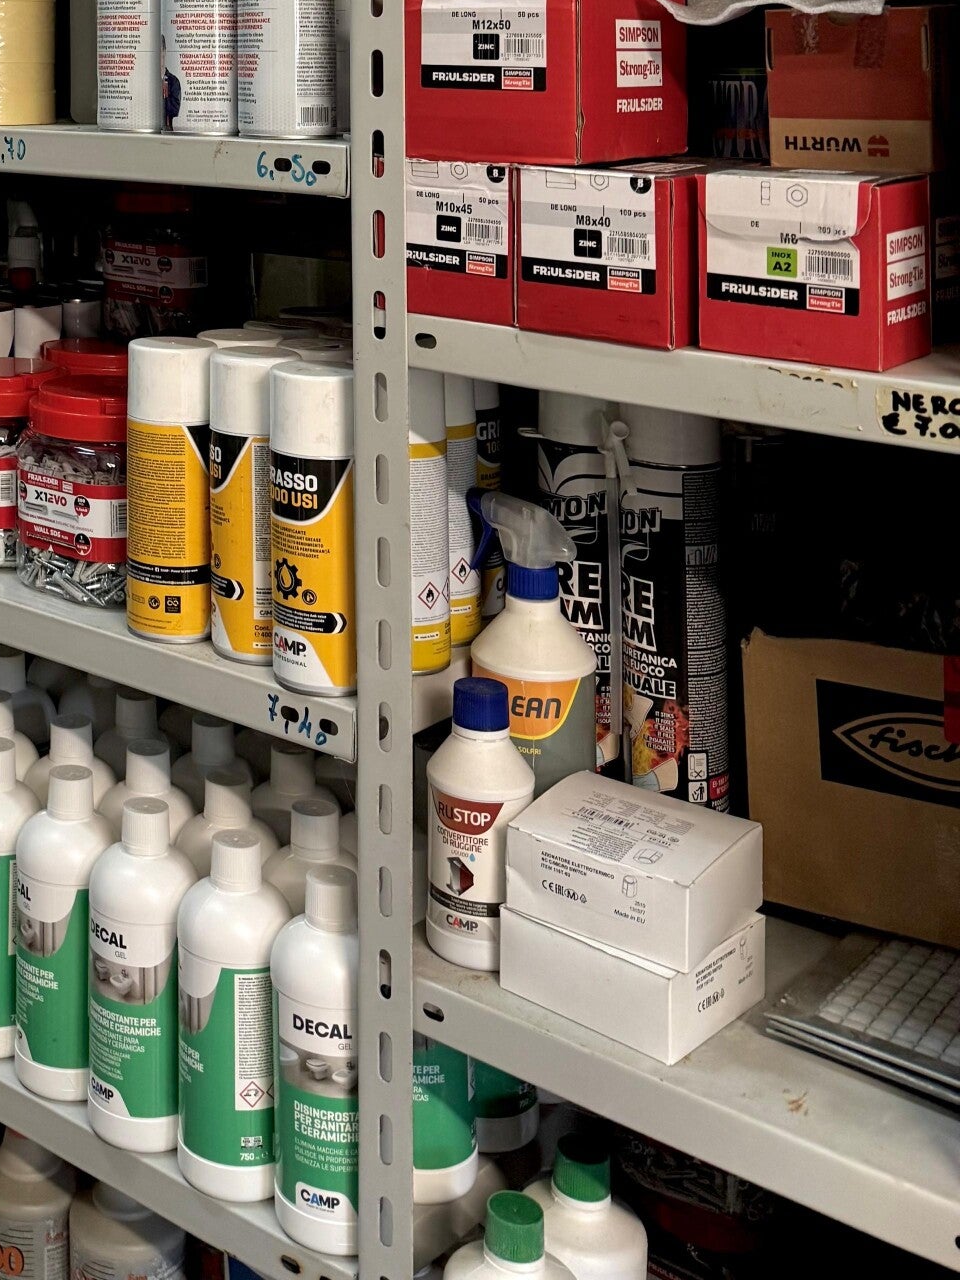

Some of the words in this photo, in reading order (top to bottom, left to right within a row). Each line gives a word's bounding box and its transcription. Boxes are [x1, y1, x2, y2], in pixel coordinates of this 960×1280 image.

[472, 19, 511, 31] M12x50
[619, 26, 659, 43] SIMPSON
[477, 43, 495, 51] ZINC
[435, 201, 473, 215] M10x45
[560, 204, 577, 212] LONG
[576, 214, 611, 228] M8x40
[578, 240, 597, 248] ZINC
[890, 234, 923, 255] SIMPSON
[771, 251, 792, 260] INOX
[610, 270, 638, 278] SIMPSON
[772, 262, 792, 273] A2
[810, 287, 842, 298] SIMPSON
[271, 468, 318, 493] RASSO
[34, 489, 68, 507] X1EVO
[291, 493, 319, 510] USI
[274, 632, 307, 656] CAMP
[511, 696, 561, 719] EAN
[438, 802, 491, 827] RUSTOP
[437, 825, 489, 847] CONVERTITORE
[450, 838, 482, 854] RUGGINE
[613, 908, 628, 919] Made
[446, 914, 478, 932] CAMP
[91, 919, 127, 949] DECAL
[115, 950, 127, 960] GEL
[41, 969, 54, 981] PER
[139, 1015, 157, 1027] PER
[292, 1013, 352, 1040] DECAL
[115, 1022, 162, 1037] CERAMICHE
[124, 1036, 139, 1045] PARA
[338, 1043, 352, 1051] GEL
[423, 1064, 440, 1075] PER
[91, 1076, 114, 1100] CAMP
[294, 1110, 311, 1126] PER
[314, 1118, 358, 1133] SANITAR
[239, 1152, 254, 1161] 750
[300, 1188, 340, 1210] CAMP
